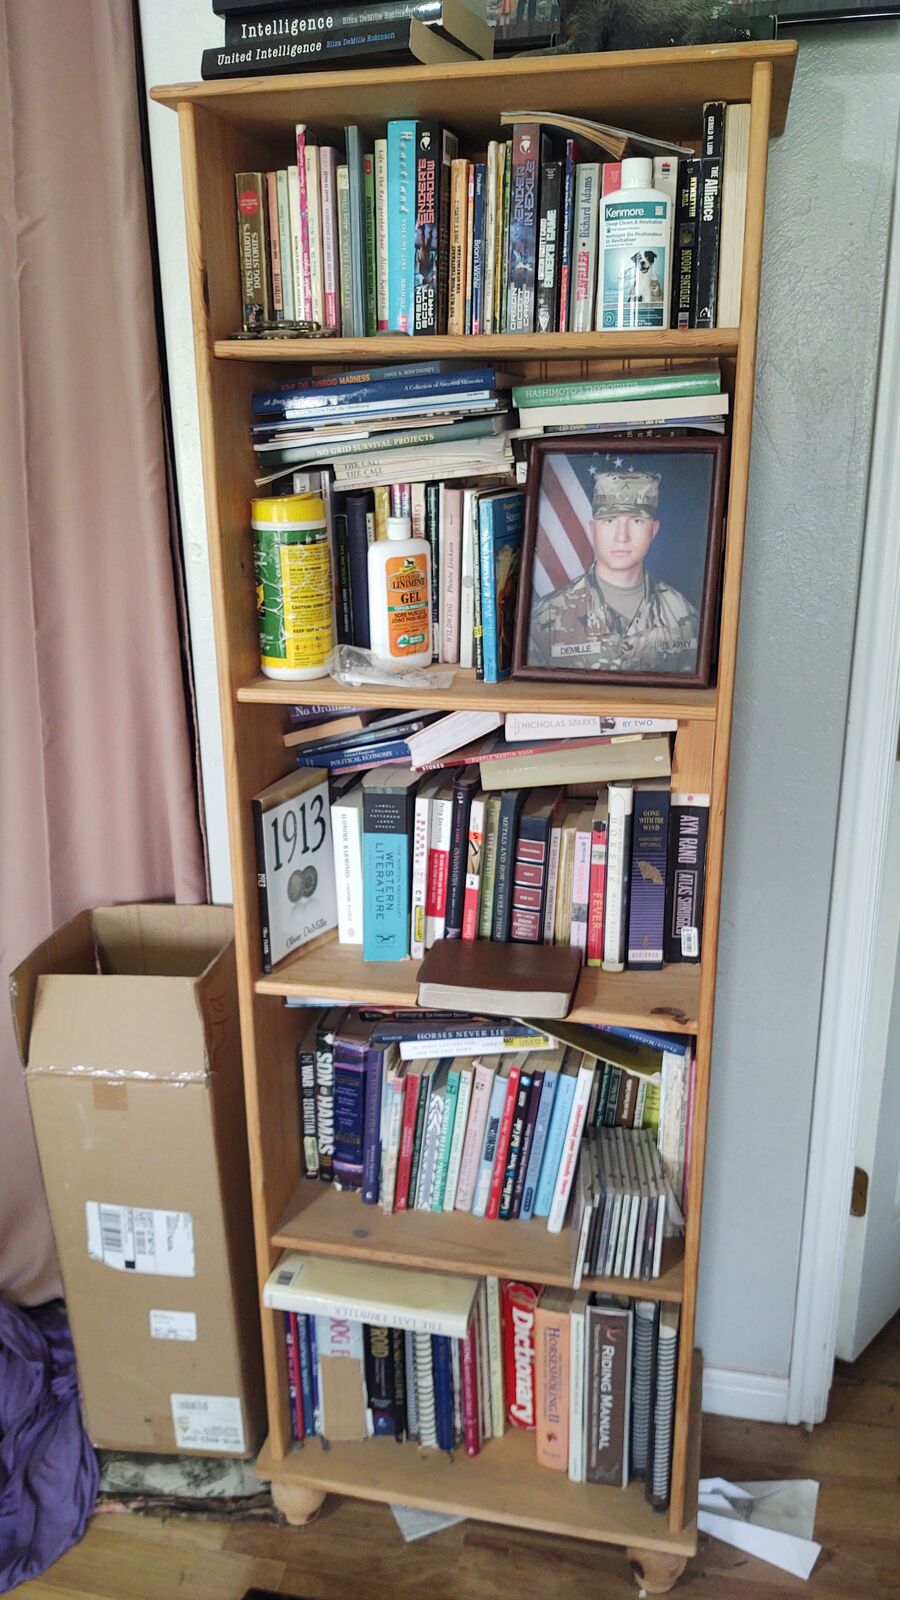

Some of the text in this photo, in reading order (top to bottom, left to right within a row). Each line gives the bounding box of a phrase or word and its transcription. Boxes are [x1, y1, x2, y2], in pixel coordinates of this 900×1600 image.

[241, 15, 333, 38] Intelligence
[343, 35, 366, 46] DeMille
[366, 31, 396, 43] Robinson
[217, 41, 322, 66] United Intelligence
[705, 116, 716, 155] GERALD LUND
[400, 131, 413, 213] Heartland
[417, 159, 426, 225] ENDER'S
[513, 165, 523, 220] ENDER
[702, 166, 719, 222] THE Alliance
[524, 212, 533, 225] IN
[606, 207, 644, 218] Kenmore
[546, 209, 557, 241] GAME
[244, 223, 252, 269] HERRIOT'S
[576, 176, 593, 301] TRAVELLER Richard Adams
[251, 232, 260, 289] DOG STORIES
[246, 270, 254, 298] JAMES
[679, 249, 692, 308] FINDING MOON
[339, 373, 370, 384] MADNESS
[525, 386, 583, 398] HASHIMOTO'S
[330, 445, 350, 455] GRID
[350, 439, 392, 452] SURVIVAL
[393, 433, 434, 446] PROJECTS
[392, 577, 425, 590] LINIMENT
[401, 591, 421, 604] GEL
[445, 602, 453, 642] WILDWING
[560, 644, 592, 655] DEMILLE
[672, 640, 692, 649] ARMY
[295, 706, 309, 717] No
[622, 718, 653, 728] BY TWO
[520, 717, 597, 730] NICHOLAS SPARKS
[330, 751, 393, 767] POLITICAL ECONOMY
[421, 763, 445, 772] STOKES
[471, 753, 494, 763] PURPLE
[642, 809, 660, 817] GONE
[271, 794, 327, 871] 1913
[500, 815, 508, 844] METALS
[678, 814, 700, 864] AYN RAND
[499, 846, 507, 862] AND
[258, 873, 266, 888] 1913
[375, 842, 384, 920] LITERATURE
[385, 852, 394, 911] WESTERN
[497, 882, 504, 892] TO
[678, 873, 694, 896] ATLAS
[592, 892, 602, 929] FEVER
[285, 918, 328, 948] Oliver DeMille
[416, 1031, 452, 1040] HORSES
[455, 1029, 488, 1038] NEVER
[301, 1065, 316, 1134] WAR SEBASTIAN
[316, 1052, 335, 1155] SON HAMAS
[502, 1177, 513, 1194] Horse
[500, 1193, 510, 1210] Good
[391, 1316, 417, 1329] LAST
[510, 1307, 535, 1425] Dictionary
[598, 1344, 615, 1450] RIDING MANUAL
